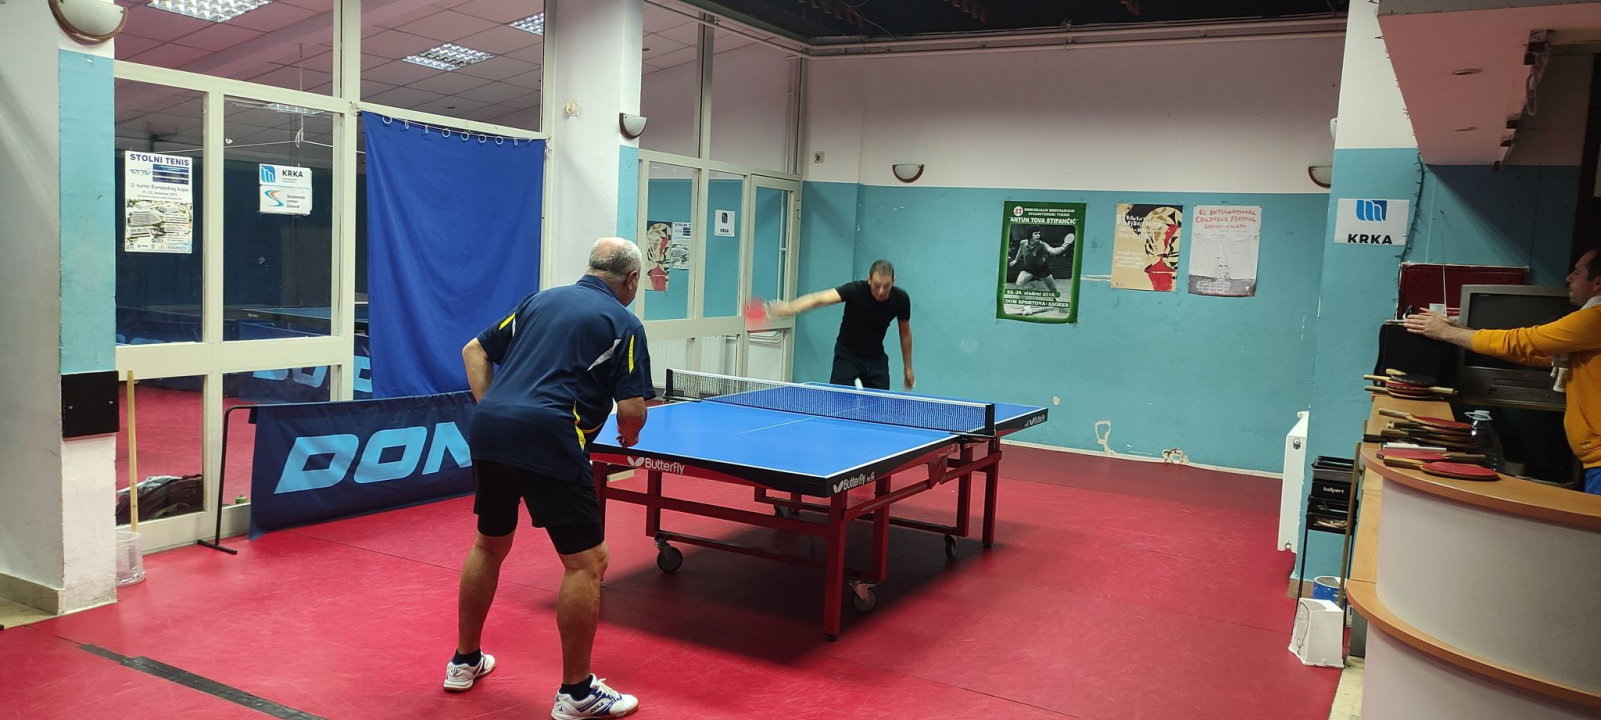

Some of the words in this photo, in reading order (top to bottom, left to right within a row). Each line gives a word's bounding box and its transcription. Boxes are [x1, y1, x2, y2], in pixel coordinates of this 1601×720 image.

[130, 154, 162, 163] STOLNI
[165, 158, 190, 166] TENIS
[1209, 208, 1257, 216] INTERNATIONAL
[1347, 233, 1393, 245] KRKA
[644, 457, 685, 475] Butterfly
[843, 473, 867, 491] Butterfly
